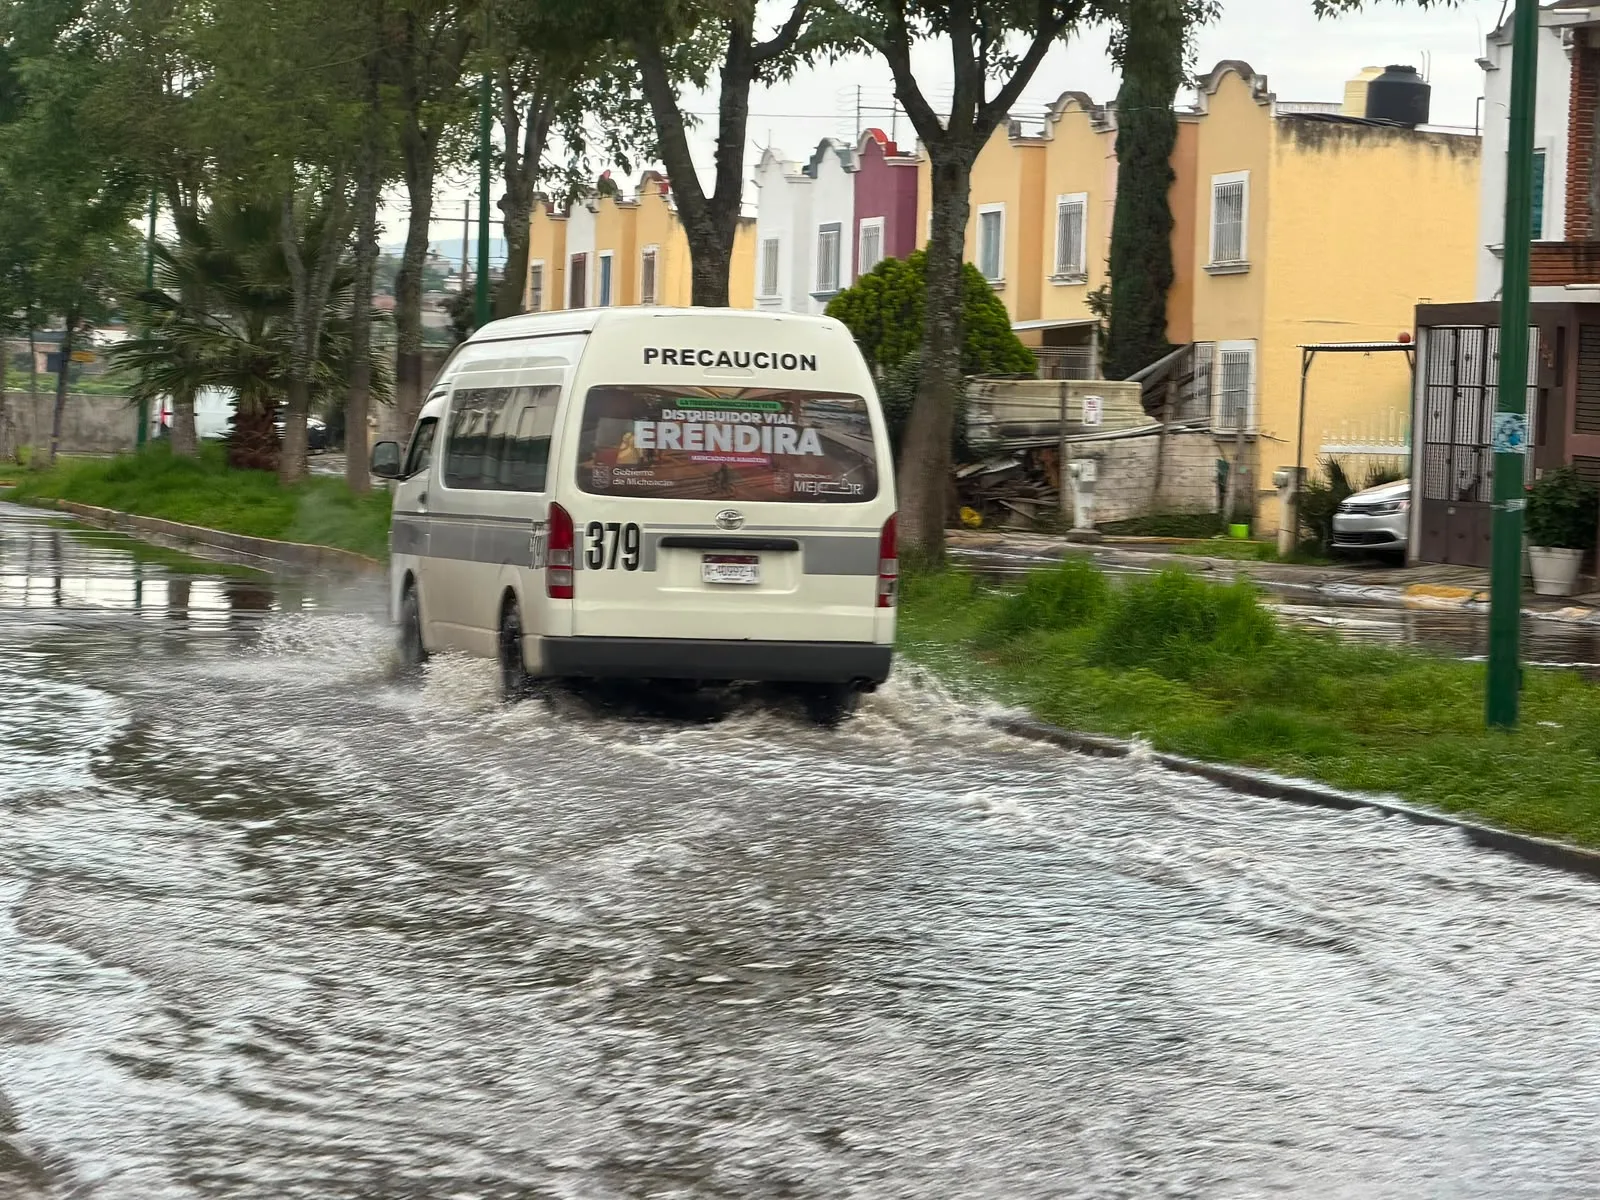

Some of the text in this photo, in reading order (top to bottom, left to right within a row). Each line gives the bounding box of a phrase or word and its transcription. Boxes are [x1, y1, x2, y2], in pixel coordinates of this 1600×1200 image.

[643, 347, 817, 371] PRECAUCION
[661, 408, 797, 425] DISTRIBUIDOR VIAL
[633, 420, 824, 457] ERENDIRA
[612, 467, 655, 476] Gobierno
[585, 521, 640, 571] 379
